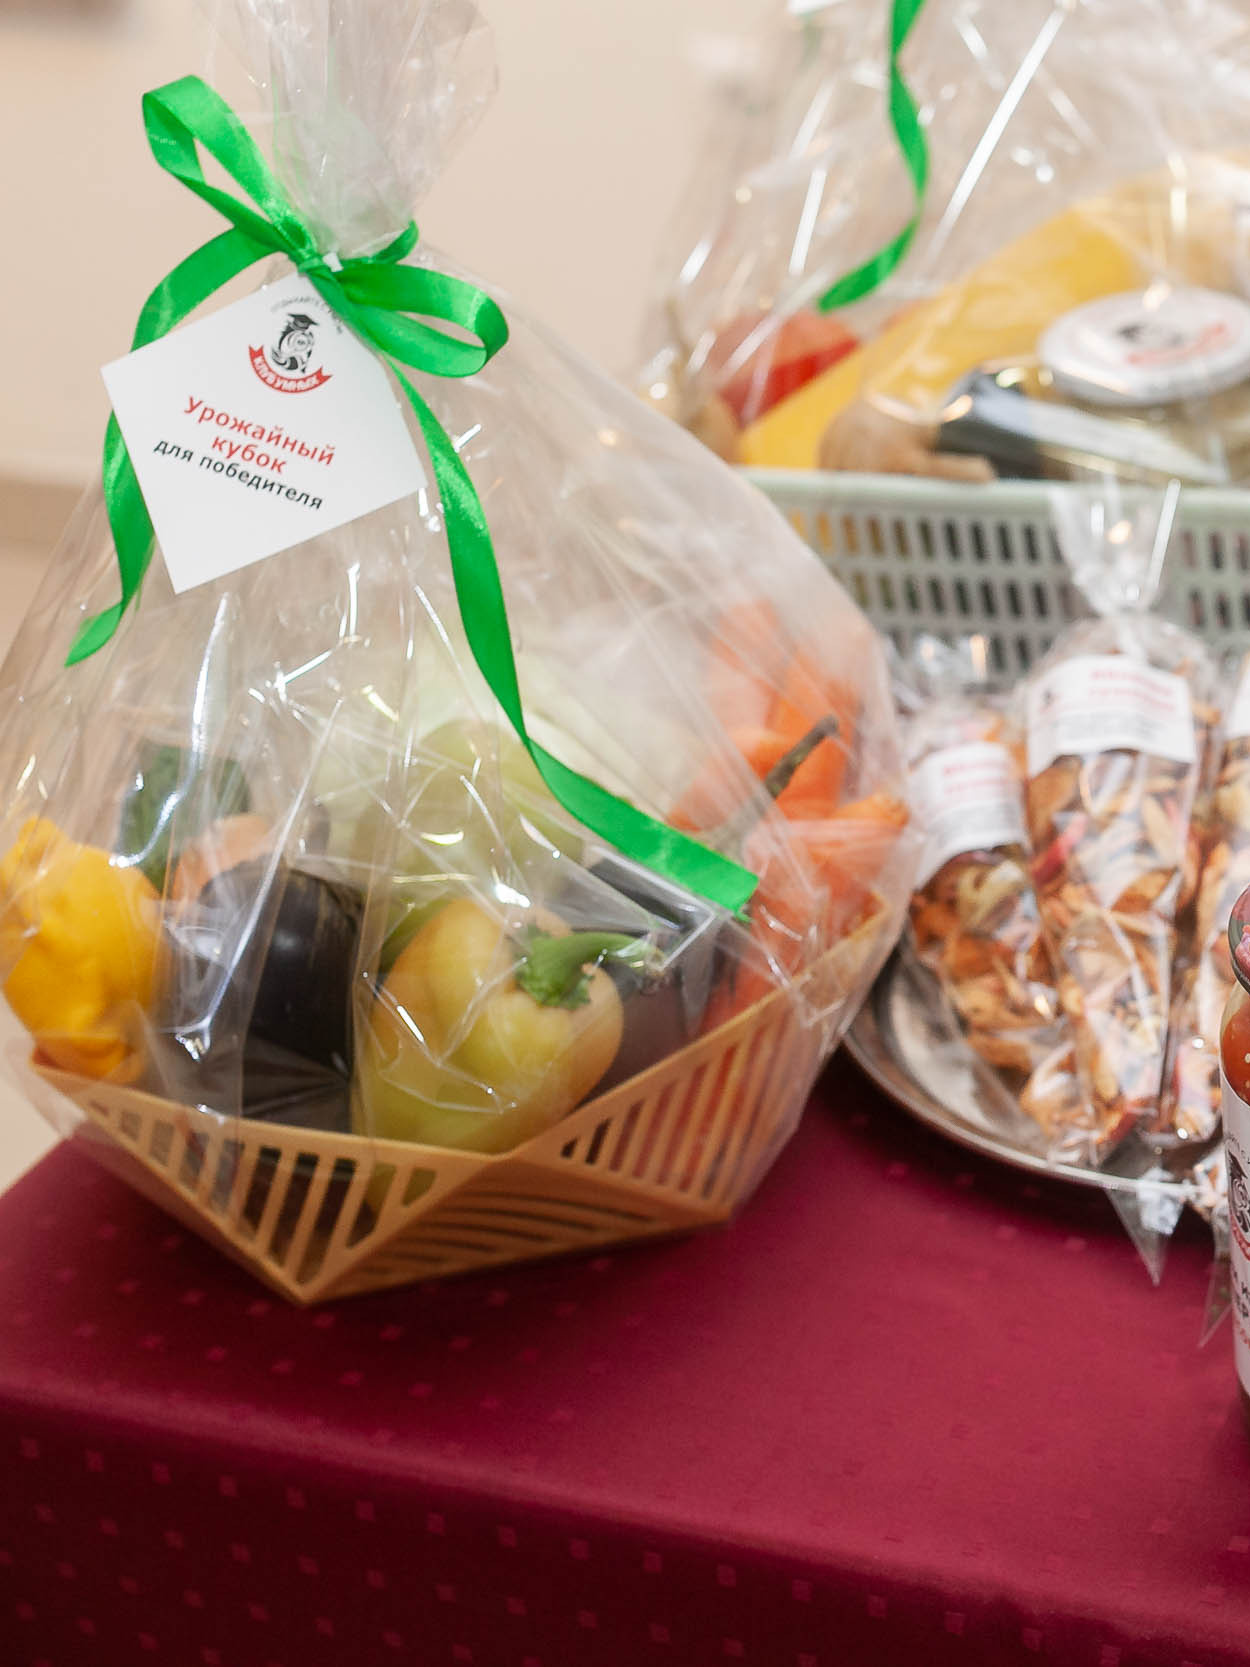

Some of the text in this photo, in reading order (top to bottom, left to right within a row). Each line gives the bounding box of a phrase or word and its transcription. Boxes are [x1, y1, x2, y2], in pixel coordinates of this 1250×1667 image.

[184, 395, 336, 466] Урожайный
[211, 436, 287, 475] кубок
[153, 440, 323, 511] для победителя
